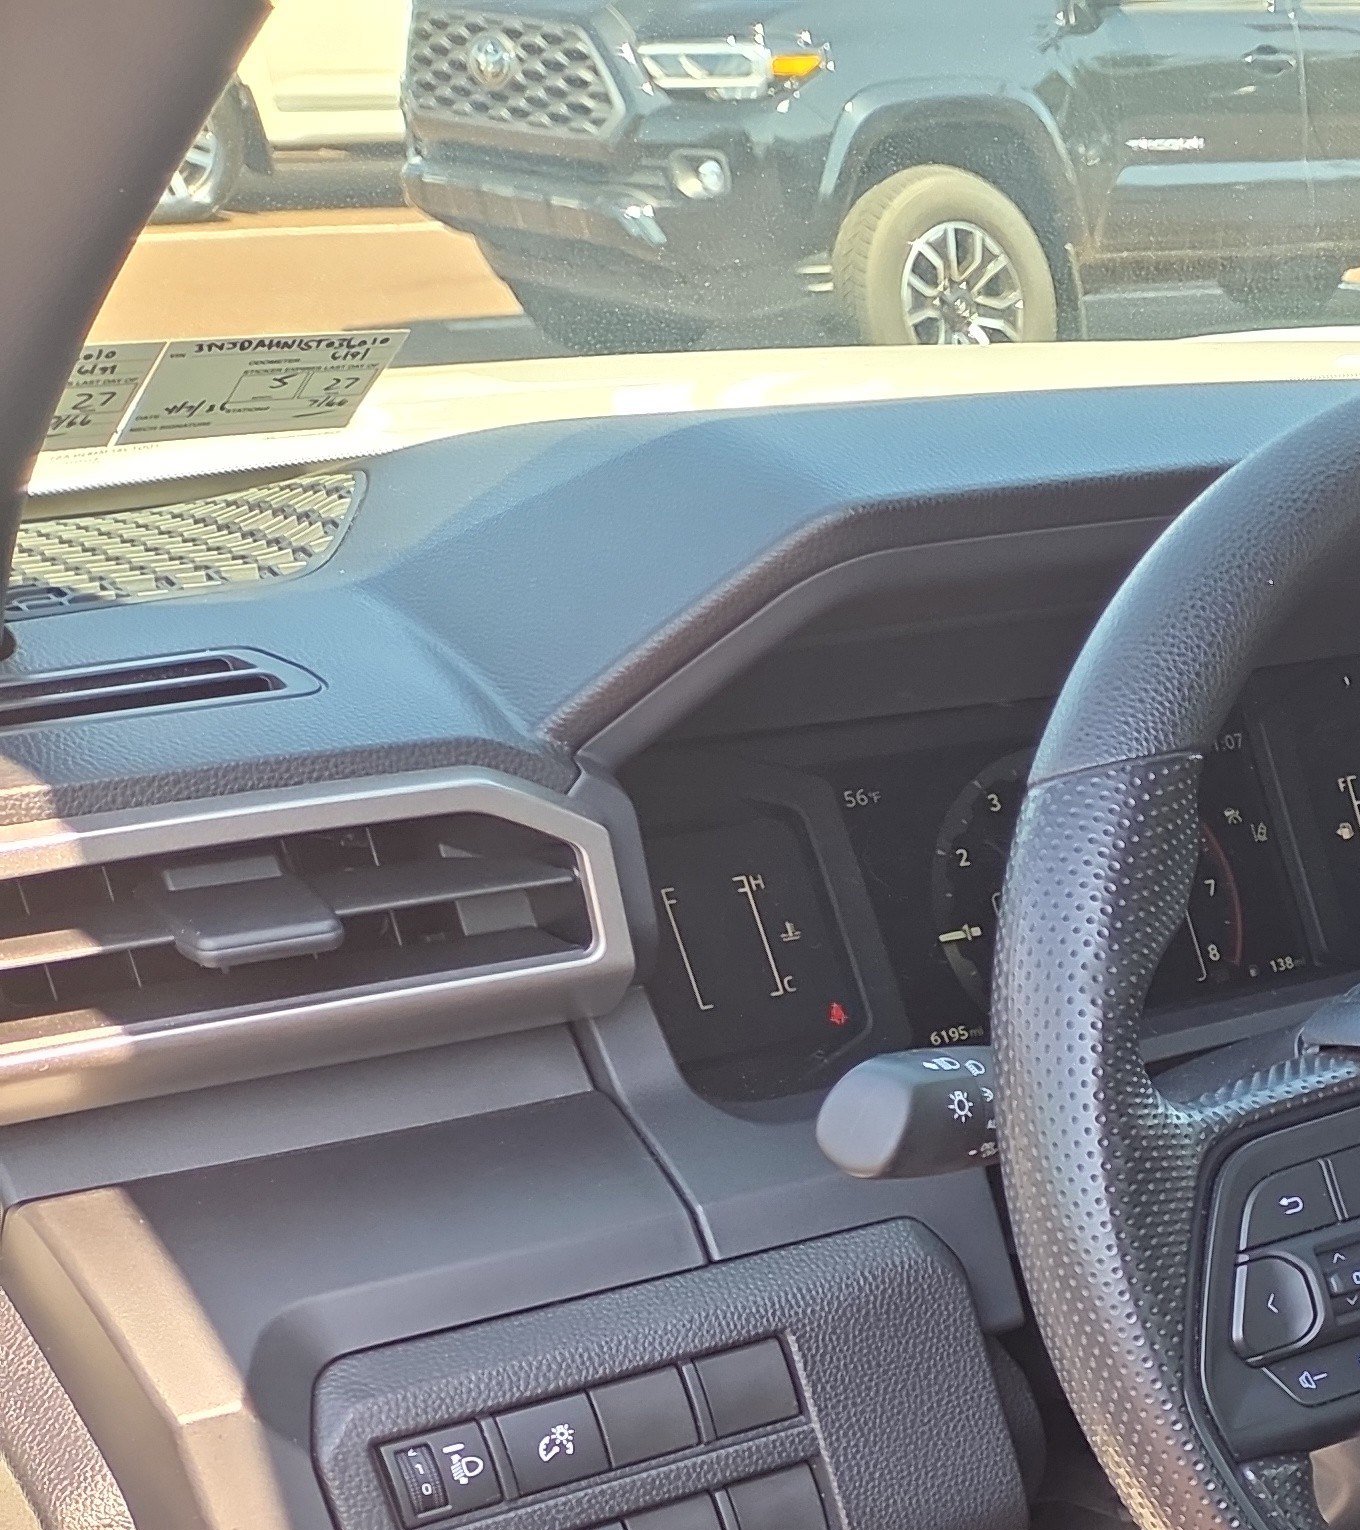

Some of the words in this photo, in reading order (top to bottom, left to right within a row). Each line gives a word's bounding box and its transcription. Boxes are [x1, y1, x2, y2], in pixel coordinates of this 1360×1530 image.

[322, 377, 361, 392] 27
[72, 391, 117, 411] 27
[1337, 777, 1346, 792] F
[987, 794, 1002, 813] 3
[956, 848, 971, 868] 2
[750, 874, 766, 892] H
[1203, 879, 1216, 897] 7
[1207, 944, 1221, 961] 8
[1269, 956, 1295, 973] 138
[783, 975, 797, 993] C
[930, 1025, 969, 1047] 6195
[421, 1483, 433, 1496] 0
